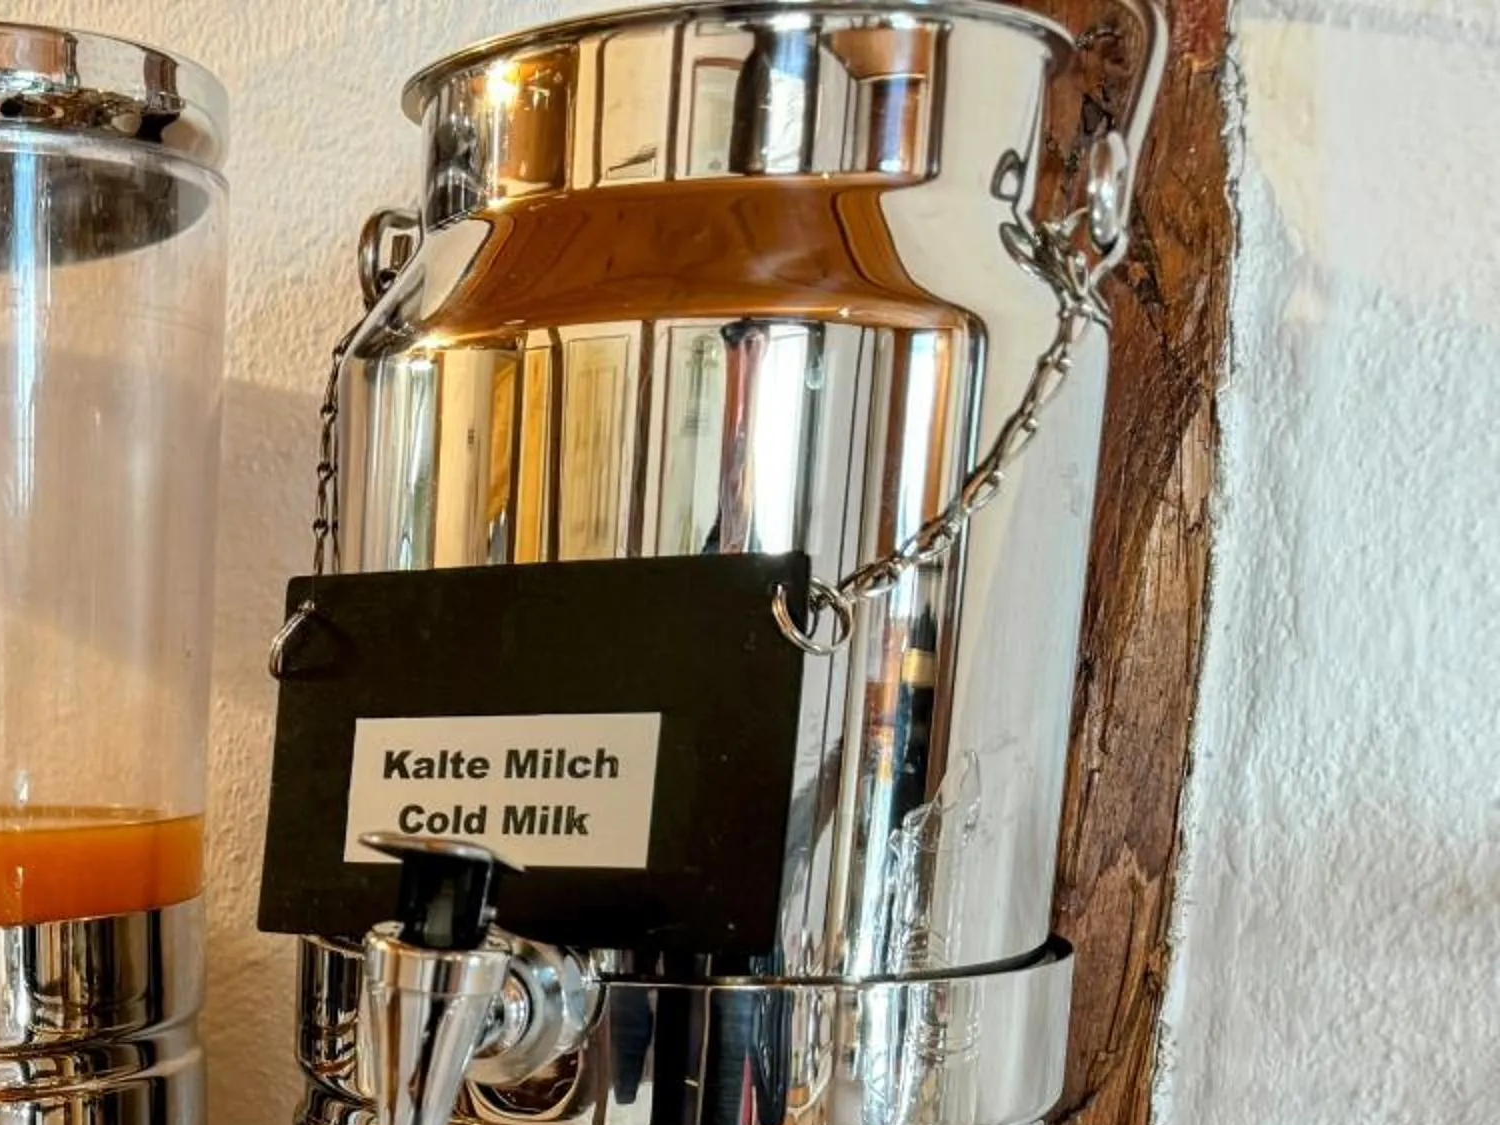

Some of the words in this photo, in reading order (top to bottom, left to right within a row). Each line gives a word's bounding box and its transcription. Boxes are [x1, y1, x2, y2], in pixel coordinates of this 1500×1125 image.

[382, 749, 490, 780] Kalte
[503, 747, 619, 779] Milch
[398, 804, 487, 835] Cold
[501, 805, 590, 836] Milk
